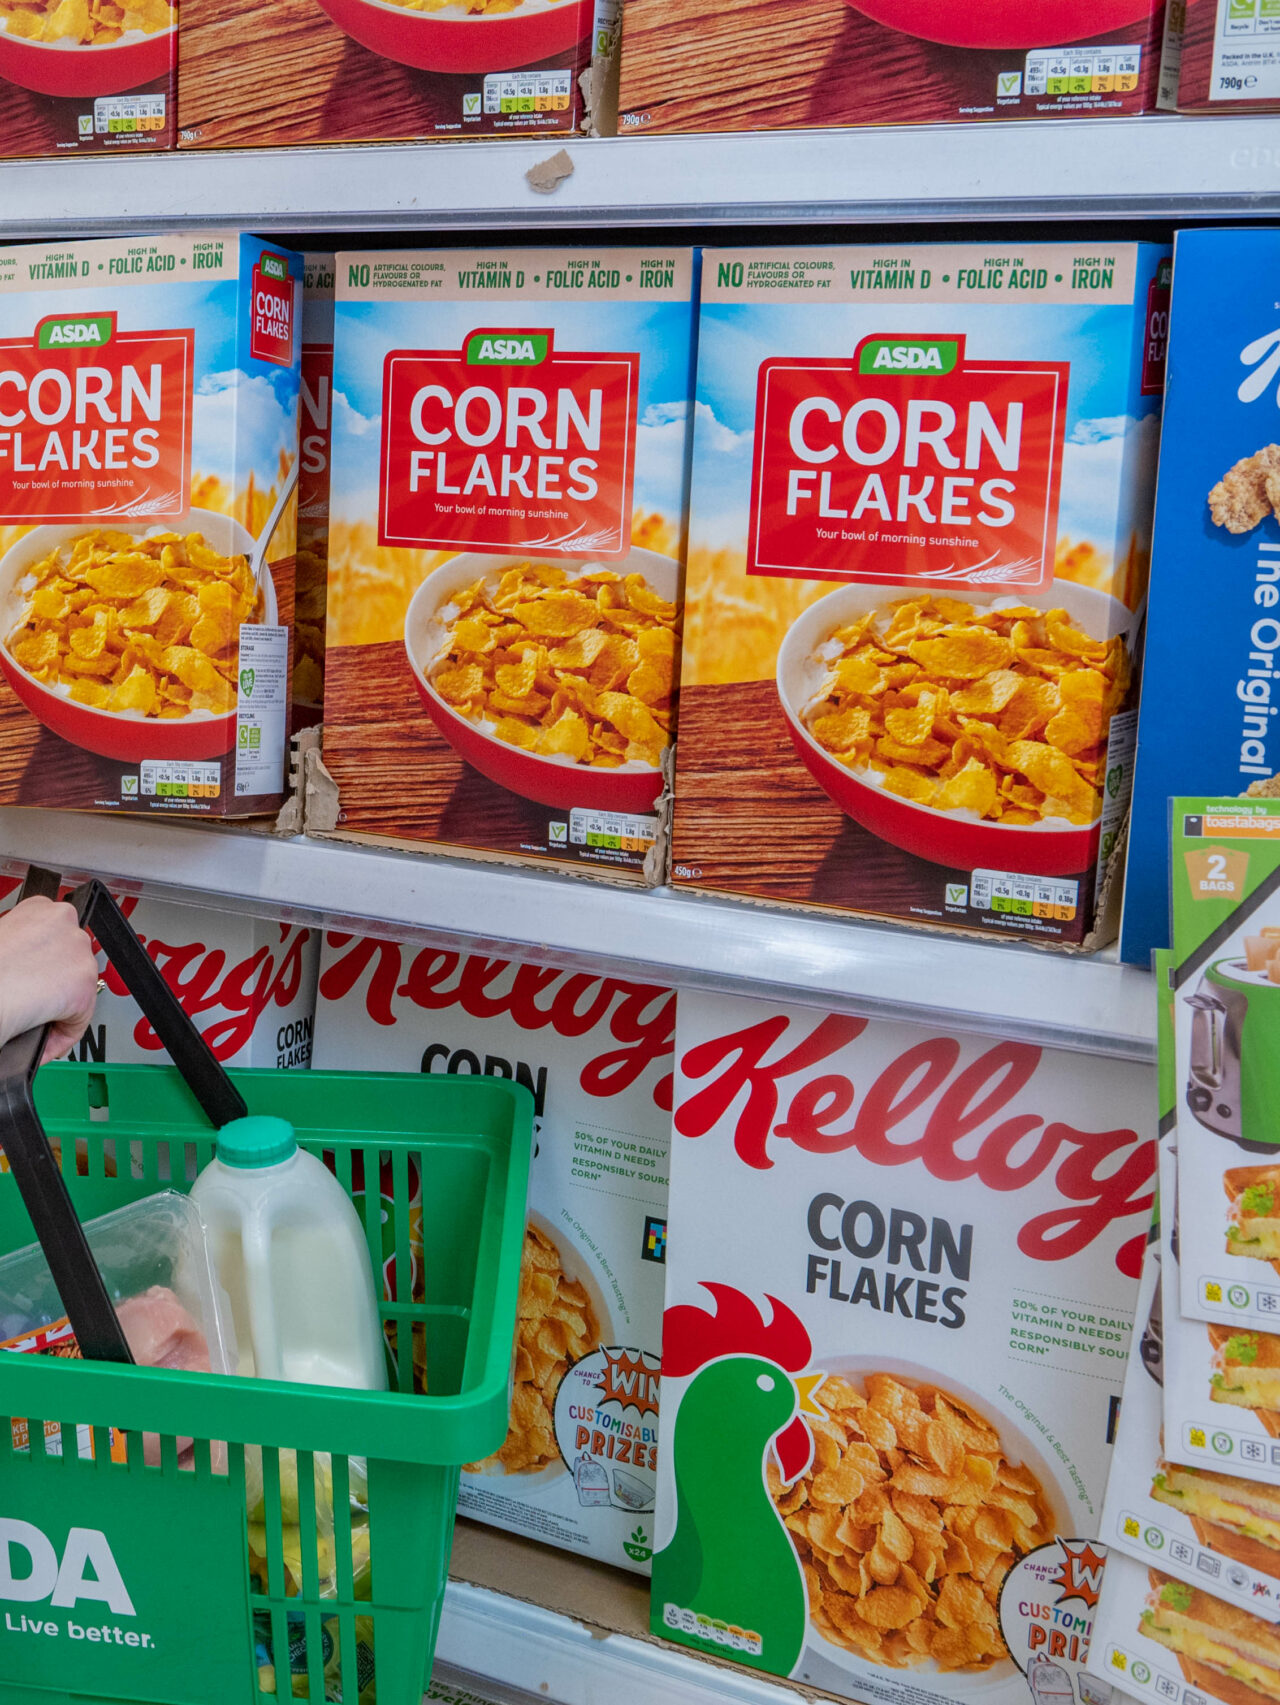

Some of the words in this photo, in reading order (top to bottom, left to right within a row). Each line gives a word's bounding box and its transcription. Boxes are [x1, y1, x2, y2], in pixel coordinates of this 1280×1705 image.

[1219, 77, 1243, 90] 790g
[622, 115, 640, 126] 790g
[29, 261, 78, 281] VITAMIN
[81, 260, 91, 277] D
[109, 257, 143, 275] FOLIC
[146, 254, 176, 273] ACID
[192, 251, 224, 270] IRON
[265, 259, 283, 277] ASDA
[373, 263, 410, 272] ARTIFICIAL
[411, 263, 446, 273] COLOURS,
[748, 261, 791, 270] ARTIFICIAL
[793, 261, 836, 272] COLOURS,
[873, 258, 898, 268] HIGH
[983, 258, 1009, 268] HIGH
[1073, 257, 1100, 267] HIGH
[348, 265, 370, 287] NO
[373, 272, 408, 280] FLAVOURS
[373, 280, 429, 288] HYDROGENATED
[458, 271, 512, 289] VITAMIN
[515, 271, 525, 288] D
[546, 271, 584, 289] FOLIC
[587, 270, 620, 288] ACID
[639, 270, 674, 288] IRON
[717, 262, 744, 288] NO
[747, 270, 790, 279] FLAVOURS
[791, 270, 805, 279] OR
[747, 279, 816, 288] HYDROGENATED
[817, 279, 832, 288] FAT
[850, 269, 916, 289] VITAMIN
[919, 269, 931, 289] D
[957, 269, 1003, 289] FOLIC
[1007, 269, 1048, 289] ACID
[1071, 267, 1113, 289] IRON
[256, 291, 289, 323] CORN
[48, 322, 102, 345] ASDA
[256, 316, 289, 341] FLAKES
[478, 339, 536, 361] ASDA
[873, 345, 943, 370] ASDA
[409, 384, 603, 452] CORN
[789, 396, 1024, 472] CORN
[12, 480, 29, 490] Your
[31, 479, 50, 489] bowl
[61, 478, 95, 491] morning
[97, 477, 134, 488] sunshine
[409, 451, 599, 501] FLAKES
[786, 469, 1017, 528] FLAKES
[434, 503, 454, 513] Your
[455, 504, 476, 514] bowl
[477, 505, 486, 514] of
[488, 506, 526, 520] morning
[527, 508, 569, 519] sunshine
[816, 528, 839, 539] Your
[841, 529, 866, 541] bowl
[868, 531, 879, 541] of
[881, 532, 926, 547] morning
[929, 534, 979, 547] sunshine
[1236, 618, 1280, 775] Original
[1206, 805, 1253, 816] technology
[1255, 805, 1267, 815] by
[674, 866, 691, 879] 450g
[1207, 854, 1227, 880] 2
[1199, 880, 1236, 893] BAGS
[276, 1015, 313, 1052] CORN
[573, 1142, 612, 1158] VITAMIN
[623, 1154, 656, 1168] NEEDS
[574, 1131, 594, 1142] 50%
[596, 1136, 609, 1145] OF
[611, 1139, 637, 1153] YOUR
[639, 1146, 668, 1159] DAILY
[572, 1157, 636, 1178] RESPONSIBLY
[560, 1208, 574, 1223] The
[572, 1221, 599, 1252] Original
[600, 1258, 613, 1278] Best
[806, 1191, 974, 1281] CORN
[805, 1253, 968, 1329] FLAKES
[1012, 1299, 1038, 1312] 50%
[1041, 1305, 1058, 1315] OF
[1061, 1308, 1096, 1324] YOUR
[1099, 1317, 1134, 1332] DAILY
[1011, 1311, 1063, 1330] VITAMIN
[1066, 1323, 1075, 1333] D
[1078, 1326, 1122, 1342] NEEDS
[1010, 1327, 1096, 1353] RESPONSIBLY
[573, 1370, 601, 1380] CHANCE
[569, 1405, 658, 1443] CUSTOMISABL
[998, 1384, 1014, 1401] The
[1015, 1399, 1050, 1435] Original
[1046, 1434, 1055, 1443] &
[1052, 1441, 1070, 1464] Best
[628, 1547, 645, 1558] x24
[1023, 1563, 1059, 1574] CHANCE
[1035, 1573, 1046, 1581] TO
[1018, 1601, 1092, 1636] CUSTOMI
[5, 1613, 59, 1637] Live
[67, 1620, 156, 1649] better.
